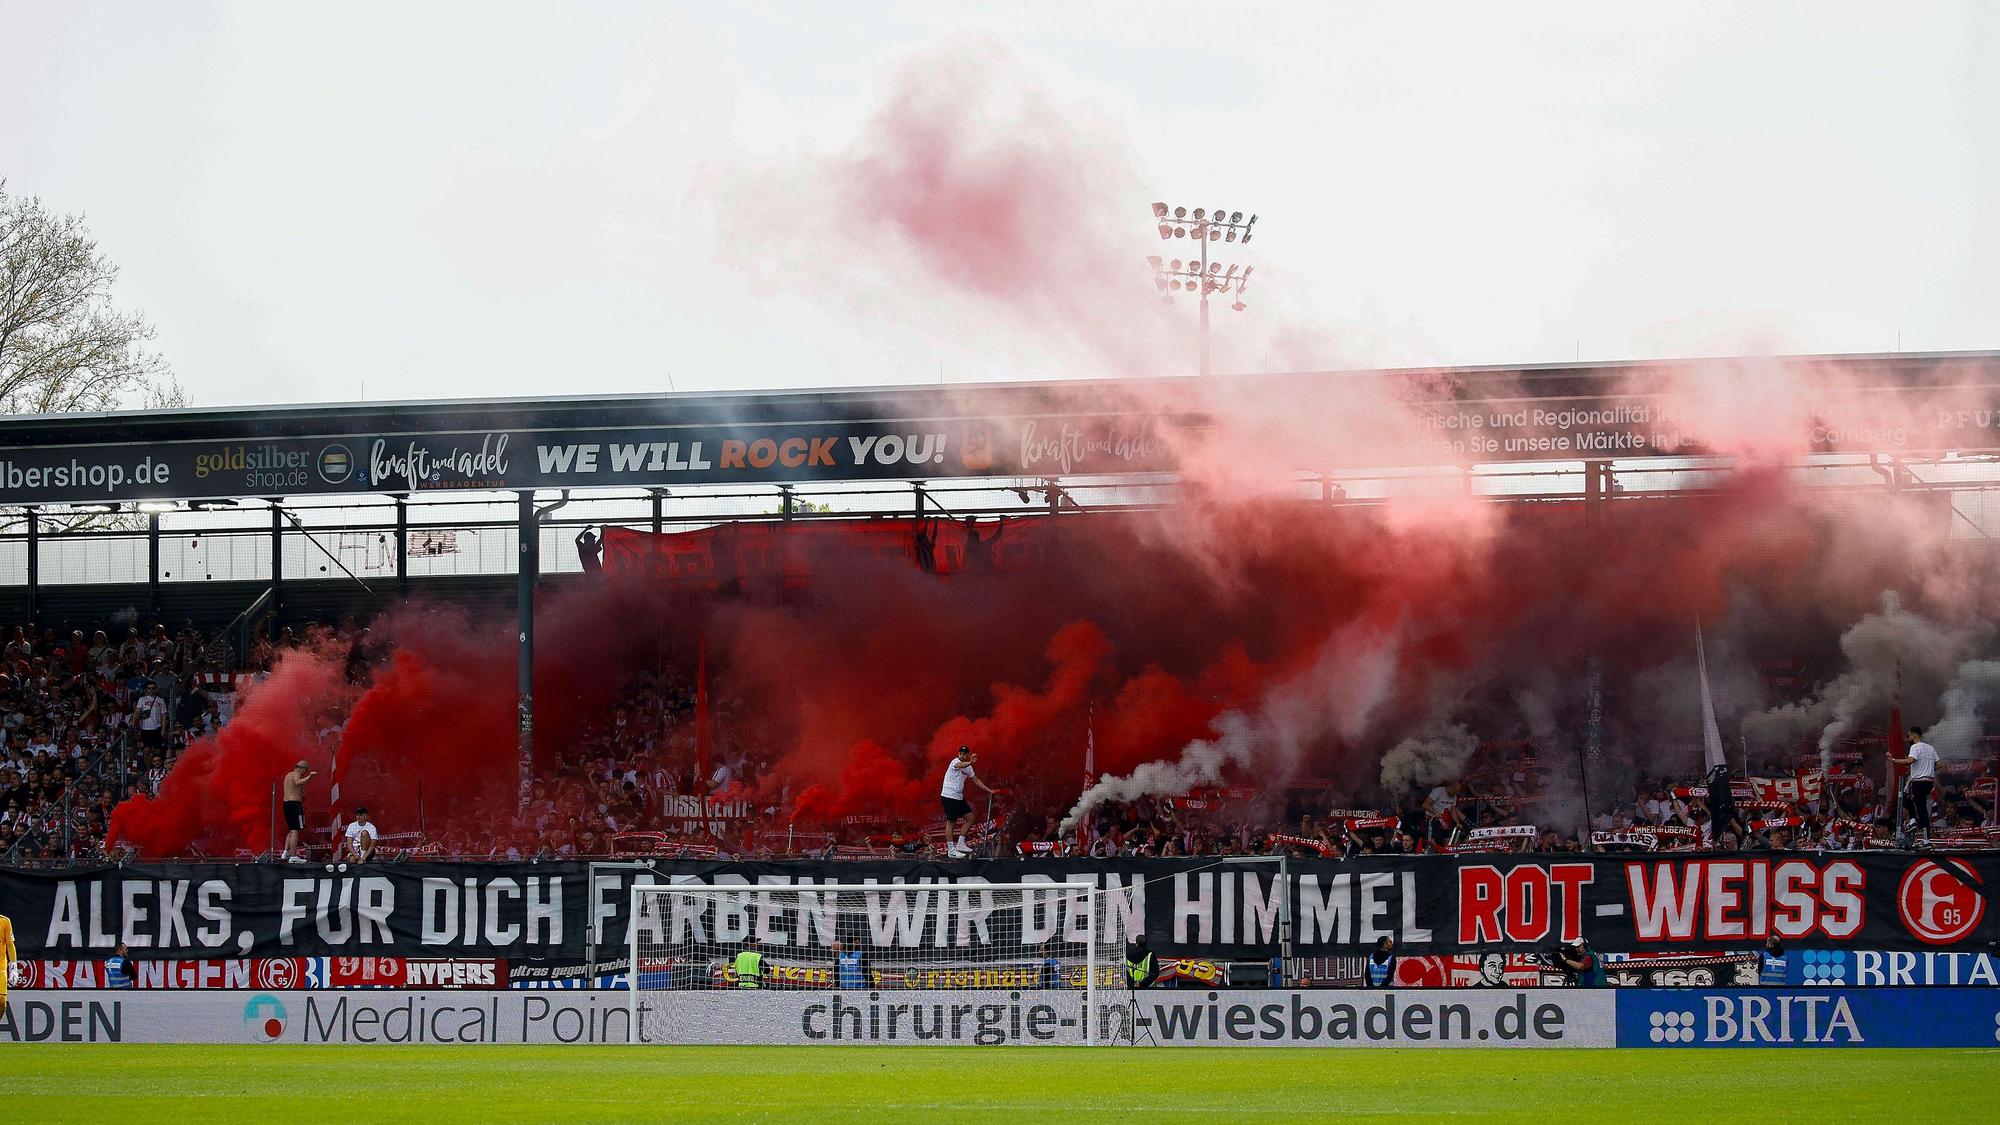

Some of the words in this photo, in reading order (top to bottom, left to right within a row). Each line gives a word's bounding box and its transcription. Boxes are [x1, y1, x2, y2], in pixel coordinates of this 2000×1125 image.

[1489, 410, 1527, 428] und
[1532, 405, 1651, 430] Regionalität
[537, 443, 600, 474] WE
[609, 441, 712, 472] WILL
[720, 437, 839, 469] ROCK
[848, 433, 947, 466] YOU!
[1020, 419, 1085, 475] kraft
[1470, 435, 1499, 453] Sie
[1505, 437, 1570, 452] unsere
[1576, 432, 1645, 450] Märkte
[195, 445, 311, 478] goldsilber
[246, 468, 308, 491] shop.de
[370, 438, 430, 490] kraft
[432, 447, 457, 470] und
[458, 433, 509, 478] adel
[419, 480, 506, 489] WERBEAGENTUR
[45, 879, 255, 955] ALEKS,
[279, 864, 395, 945] FÜR
[420, 876, 563, 945] DICH
[594, 873, 839, 947] FARBEN
[863, 875, 994, 947] WIR
[1020, 872, 1146, 945] DEN
[1173, 871, 1433, 945] HIMMEL
[1457, 858, 1867, 945] ROT-WEISS
[406, 962, 496, 985] HYPERS
[510, 965, 549, 978] ultras
[1853, 950, 1999, 986] BRITA
[303, 995, 499, 1043] Medical
[522, 996, 652, 1044] Point
[802, 992, 1565, 1046] chirurgie-in-wiesbaden.de
[1703, 995, 1865, 1043] BRITA
